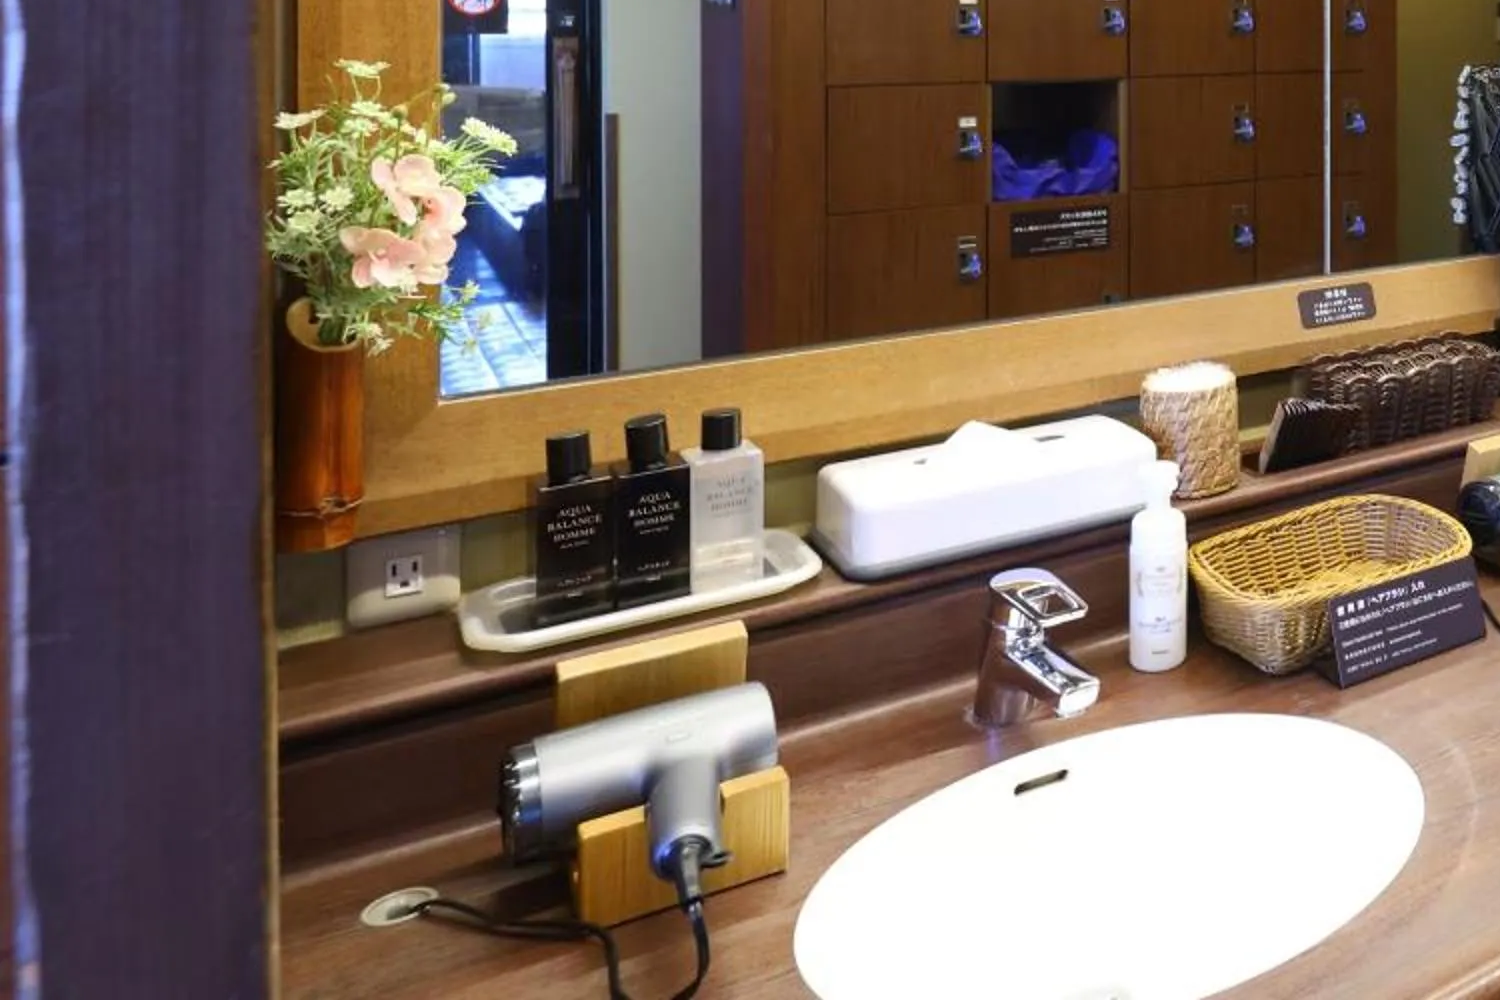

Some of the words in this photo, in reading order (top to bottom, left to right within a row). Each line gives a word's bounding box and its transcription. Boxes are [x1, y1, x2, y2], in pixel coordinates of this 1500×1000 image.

[639, 491, 671, 505] AQUA
[558, 503, 592, 518] AQUA
[628, 501, 680, 518] BALANCE
[547, 514, 602, 533] BALANCE
[553, 527, 596, 543] HOMME
